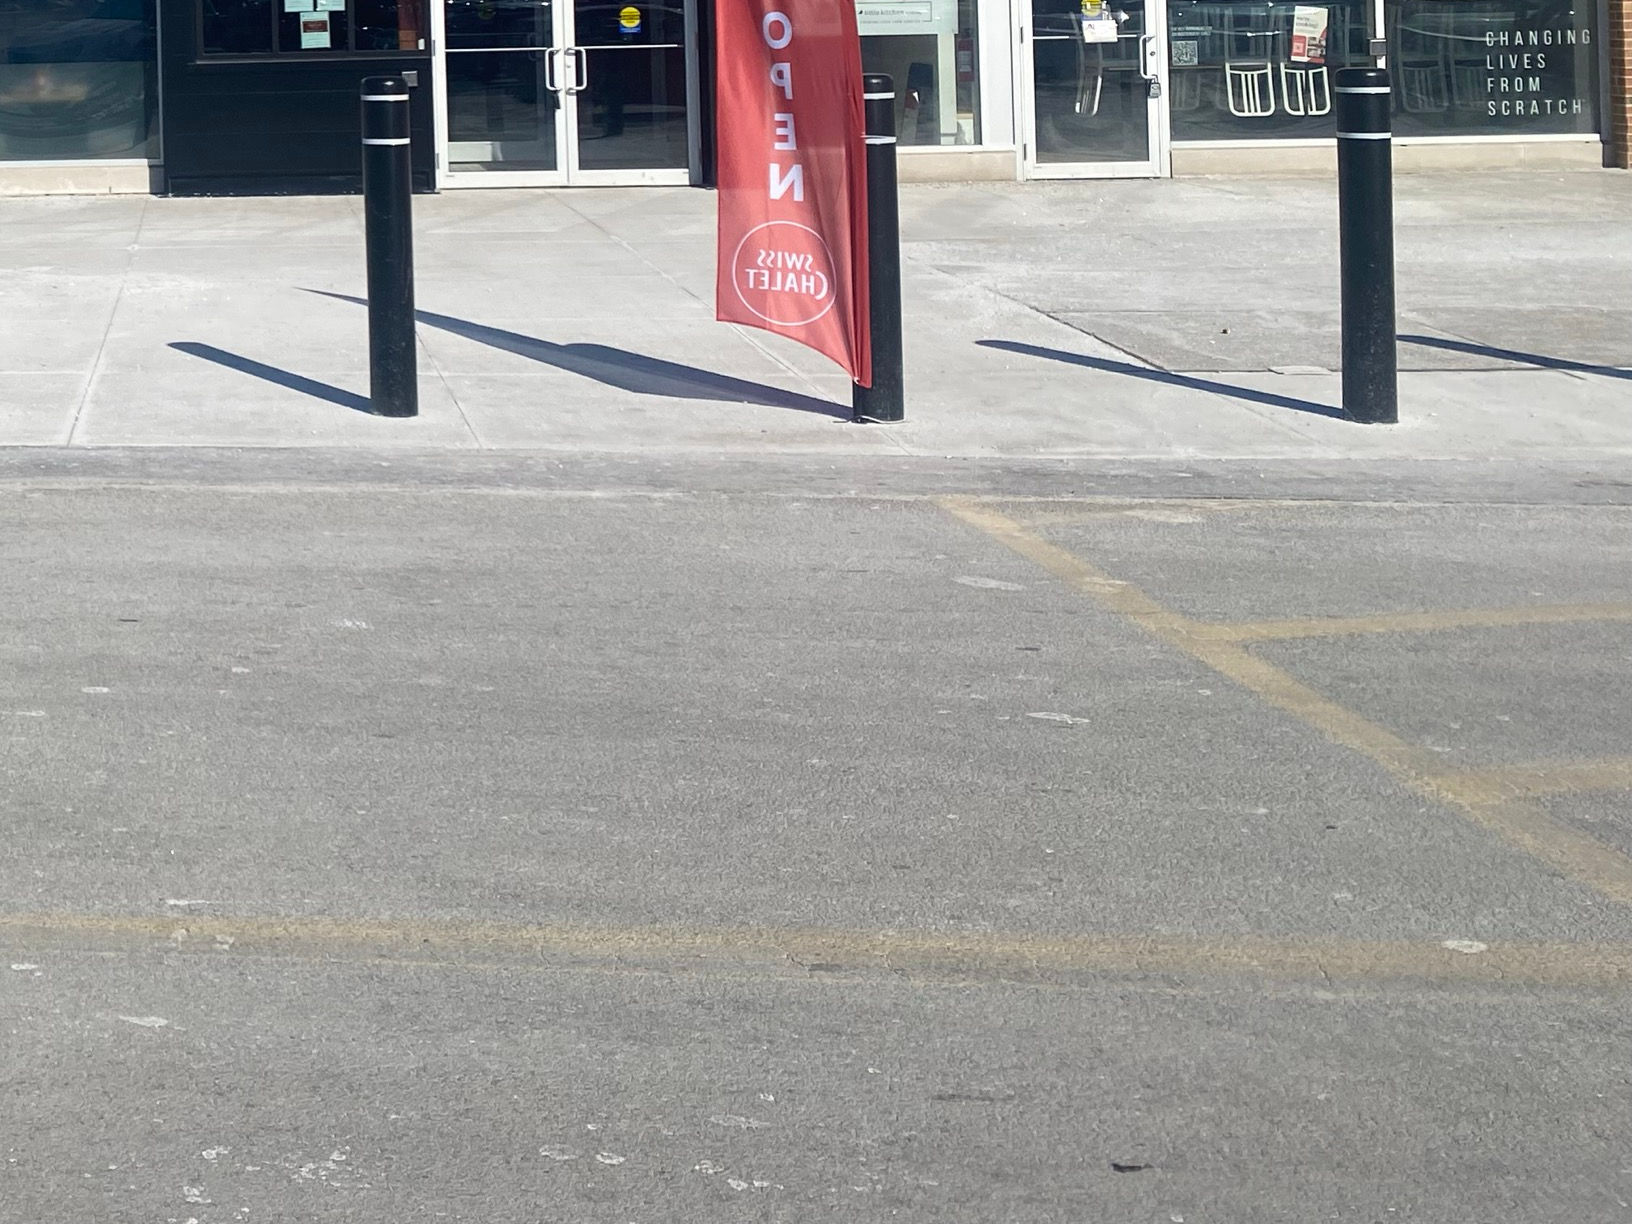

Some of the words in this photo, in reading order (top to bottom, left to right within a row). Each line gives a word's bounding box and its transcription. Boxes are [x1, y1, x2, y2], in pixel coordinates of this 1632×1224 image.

[1485, 29, 1591, 47] CHANGING
[1486, 53, 1547, 70] LIVES
[1487, 76, 1541, 93] FROM
[1487, 99, 1582, 117] SCRATCH
